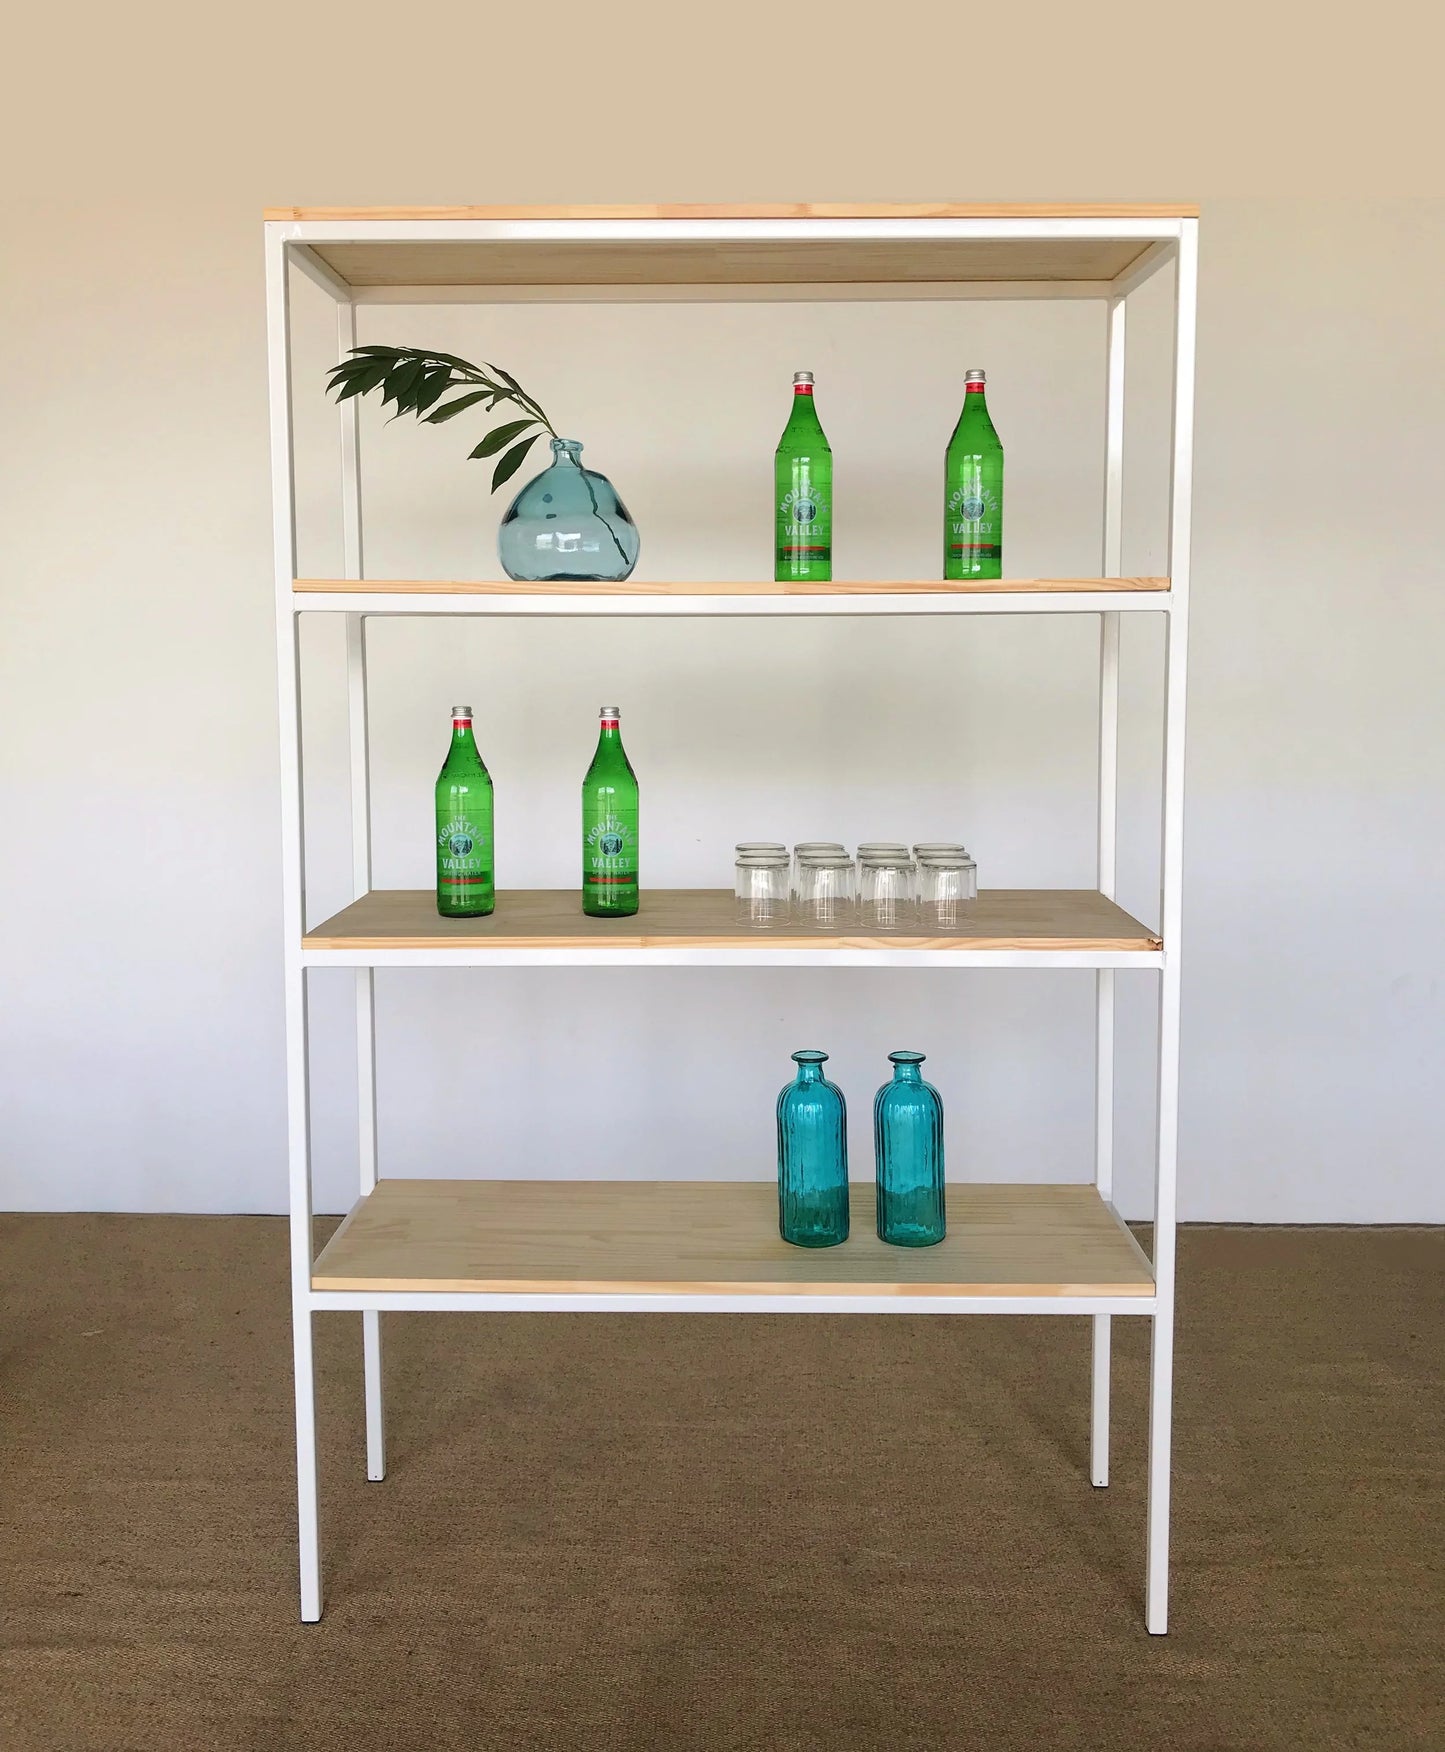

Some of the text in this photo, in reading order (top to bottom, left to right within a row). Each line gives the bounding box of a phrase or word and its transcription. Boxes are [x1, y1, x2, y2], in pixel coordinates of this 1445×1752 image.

[948, 485, 998, 511] MOUNTAIN
[785, 525, 824, 536] VALLEY
[953, 522, 992, 533] VALLEY
[438, 821, 486, 847] MOUNTAIN
[587, 821, 634, 846] MOUNTAIN
[442, 858, 481, 869] VALLEY
[592, 857, 630, 868] VALLEY
